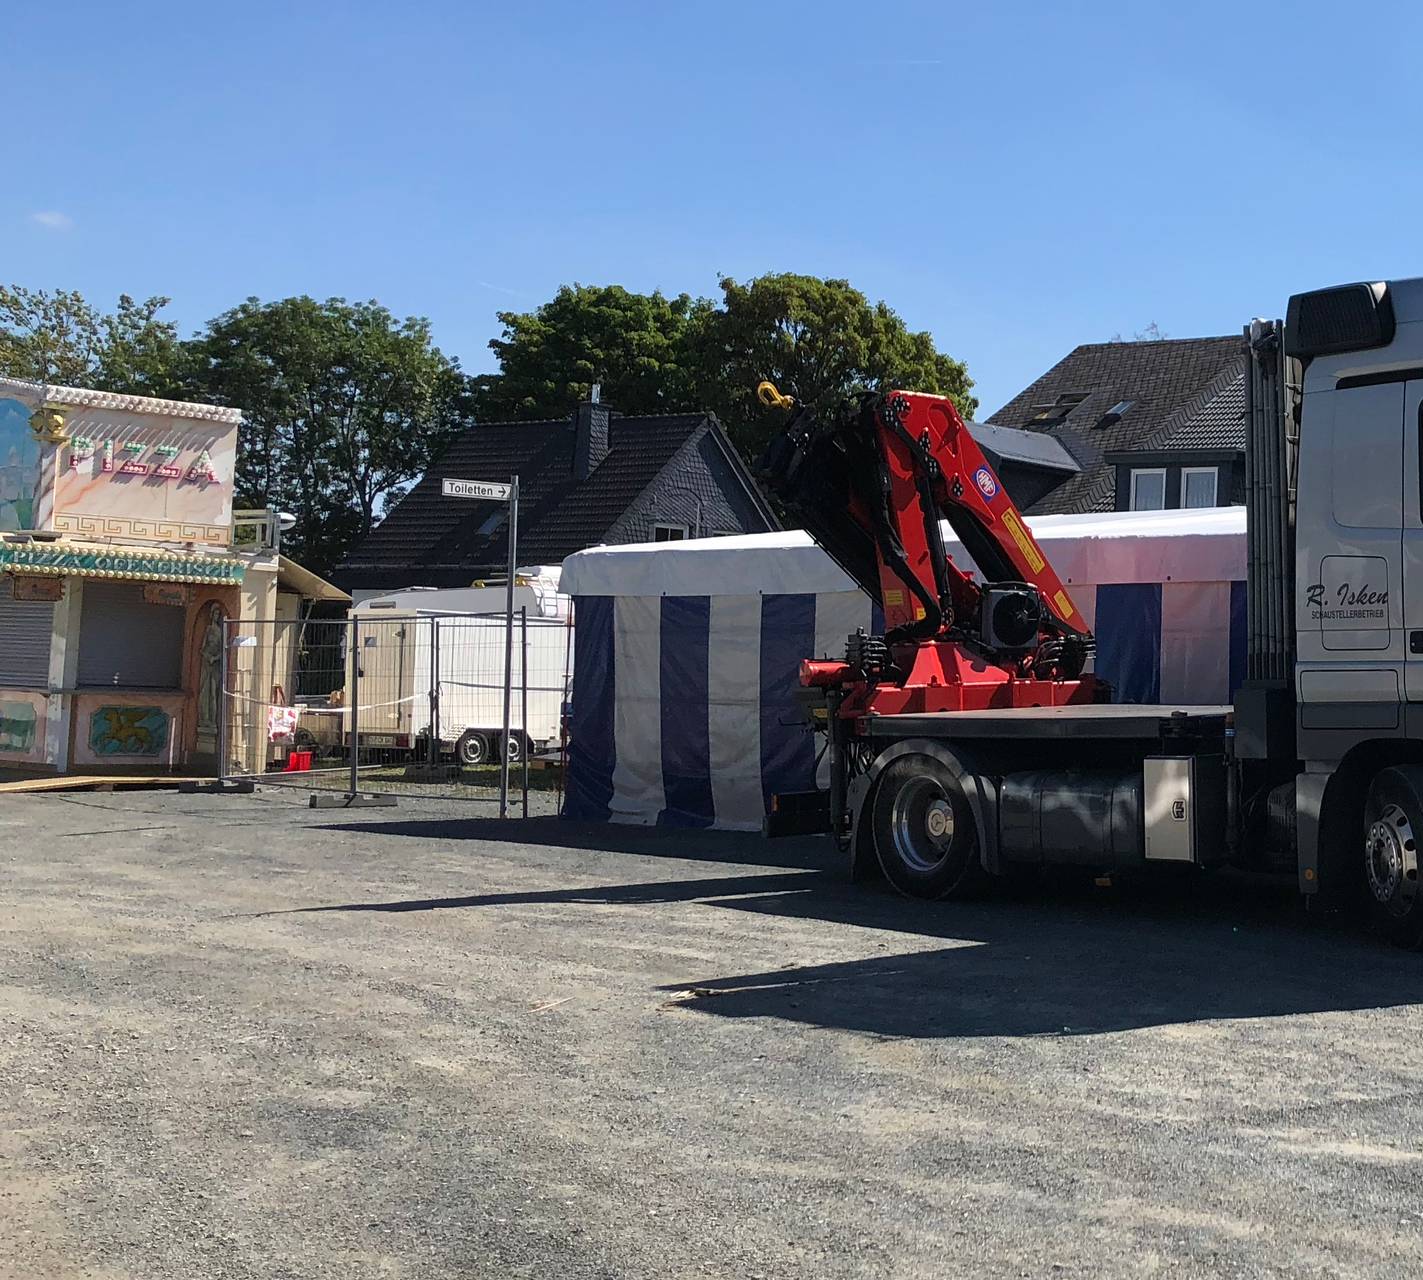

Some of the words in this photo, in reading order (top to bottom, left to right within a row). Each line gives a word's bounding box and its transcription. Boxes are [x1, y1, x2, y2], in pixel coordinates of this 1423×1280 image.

[69, 435, 221, 484] PIZZA
[448, 482, 494, 496] Toiletten
[978, 472, 994, 492] HMF
[13, 550, 81, 567] PIZZA
[1306, 584, 1329, 607] R.
[1337, 582, 1389, 606] Isken
[1311, 609, 1384, 619] SCHAUSTELLERBETRIEB
